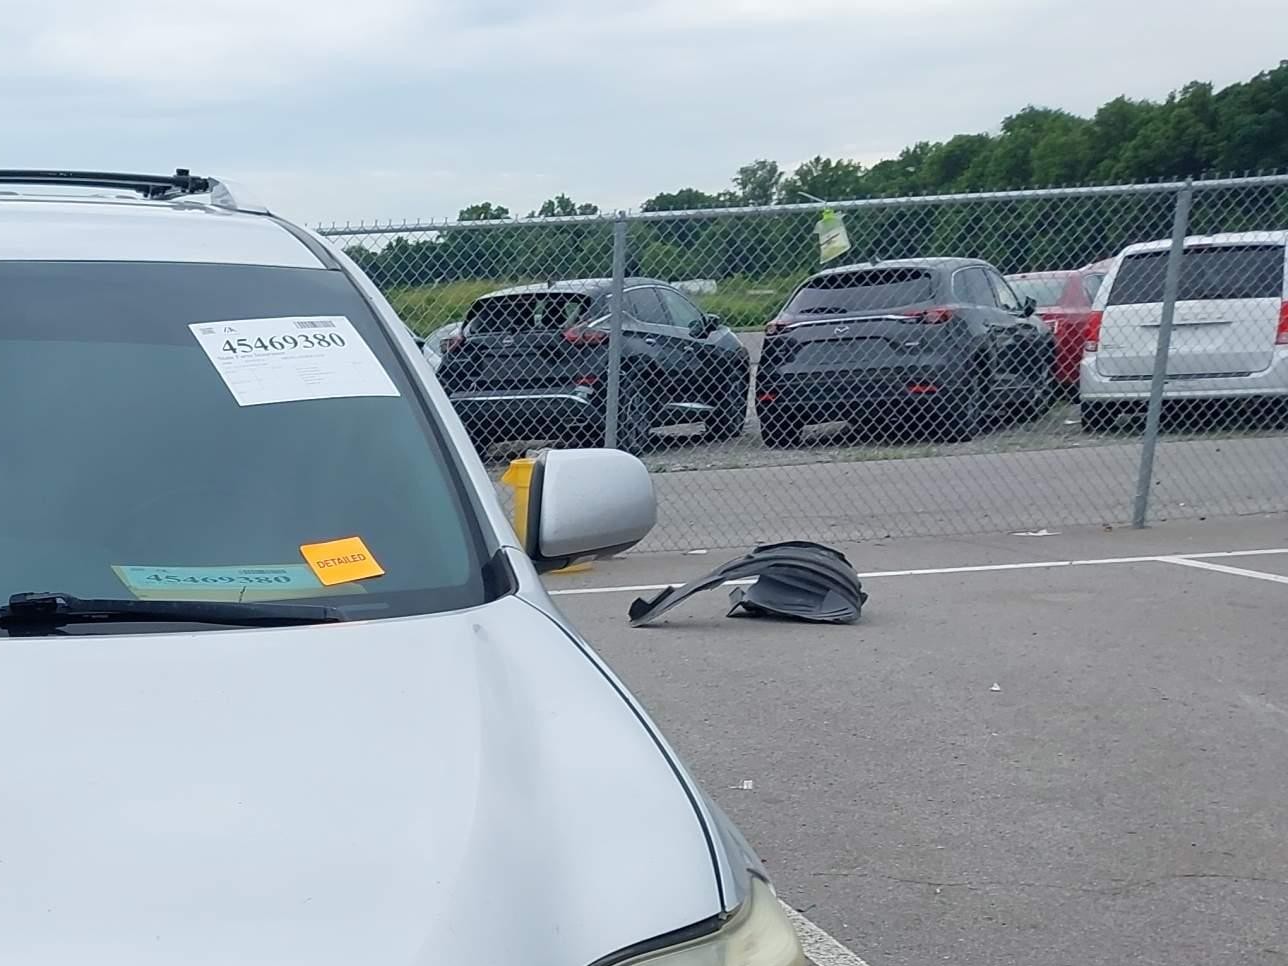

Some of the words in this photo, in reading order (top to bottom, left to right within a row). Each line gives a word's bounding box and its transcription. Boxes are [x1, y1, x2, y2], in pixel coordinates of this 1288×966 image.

[222, 331, 347, 354] 45469380
[316, 553, 367, 569] DETAILED
[146, 573, 292, 584] 45469380
